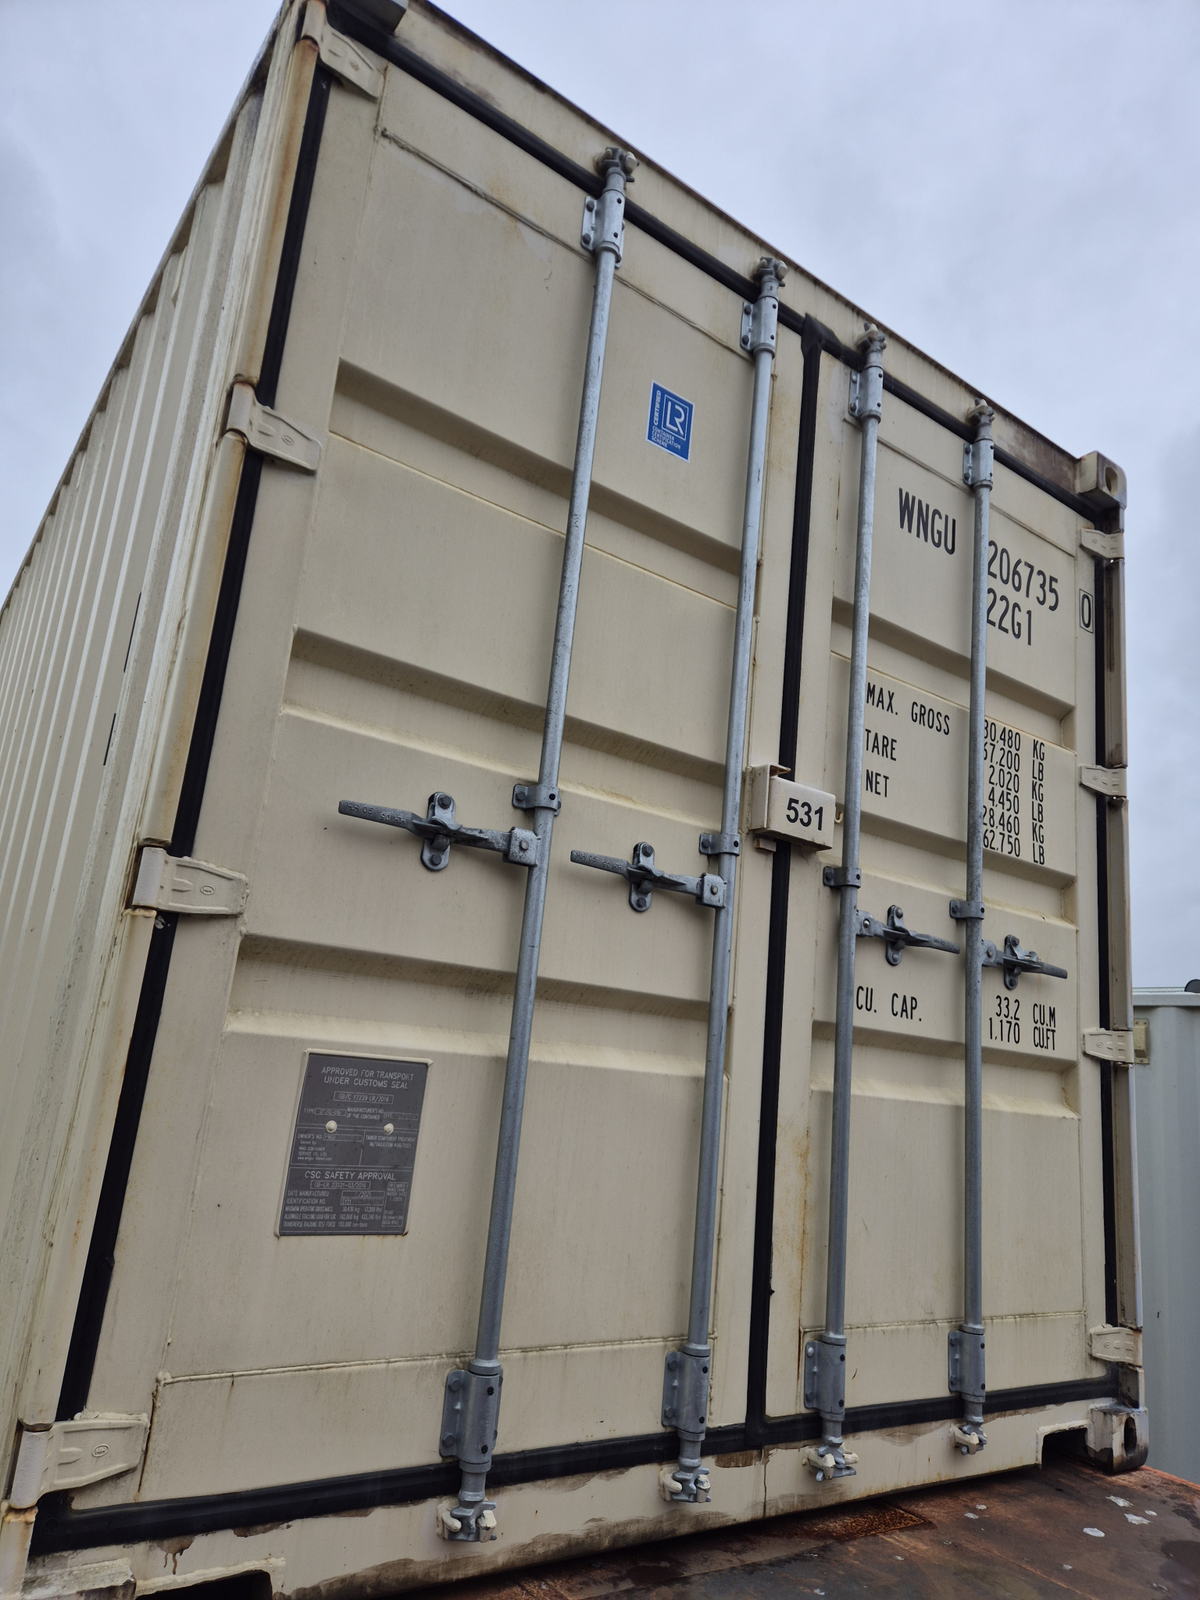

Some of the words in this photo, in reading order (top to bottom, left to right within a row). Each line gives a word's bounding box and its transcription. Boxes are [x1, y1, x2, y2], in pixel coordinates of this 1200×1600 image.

[652, 425, 675, 441] CONTAINER
[665, 400, 685, 436] LR
[651, 430, 681, 450] CERTIFICATION
[899, 487, 956, 555] WNGU
[987, 540, 1059, 611] 206735
[1081, 593, 1092, 629] 0
[987, 587, 1032, 646] 22G1
[866, 682, 898, 715] MAX.
[911, 701, 950, 735] GROSS
[1032, 738, 1045, 762] KG
[865, 728, 897, 761] TARE
[988, 765, 1020, 793] 2,020
[1031, 780, 1044, 803] KG
[1032, 759, 1044, 782] LB
[786, 797, 824, 831] 531
[865, 769, 890, 798] NET
[983, 805, 1020, 836] 28,460
[1032, 822, 1045, 844] KG
[988, 787, 1020, 815] 4,450
[1031, 800, 1044, 823] LB
[983, 829, 1021, 857] 62,750
[1032, 843, 1045, 865] LB
[856, 985, 877, 1013] CU.
[891, 993, 922, 1022] CAP.
[995, 995, 1020, 1021] 33.2
[1032, 1003, 1056, 1028] CU.M
[989, 1017, 1020, 1044] 1,170
[1033, 1026, 1056, 1051] CU.FT
[321, 1066, 358, 1077] APPROVED
[360, 1069, 375, 1078] FOR
[376, 1070, 414, 1081] TRANSPORT
[324, 1076, 350, 1085] UNDER
[353, 1078, 388, 1089] CUSTOMS
[391, 1081, 408, 1089] SEAL
[304, 1170, 321, 1179] CSC
[324, 1171, 355, 1180] SAFETY
[357, 1172, 396, 1181] APPROVAL
